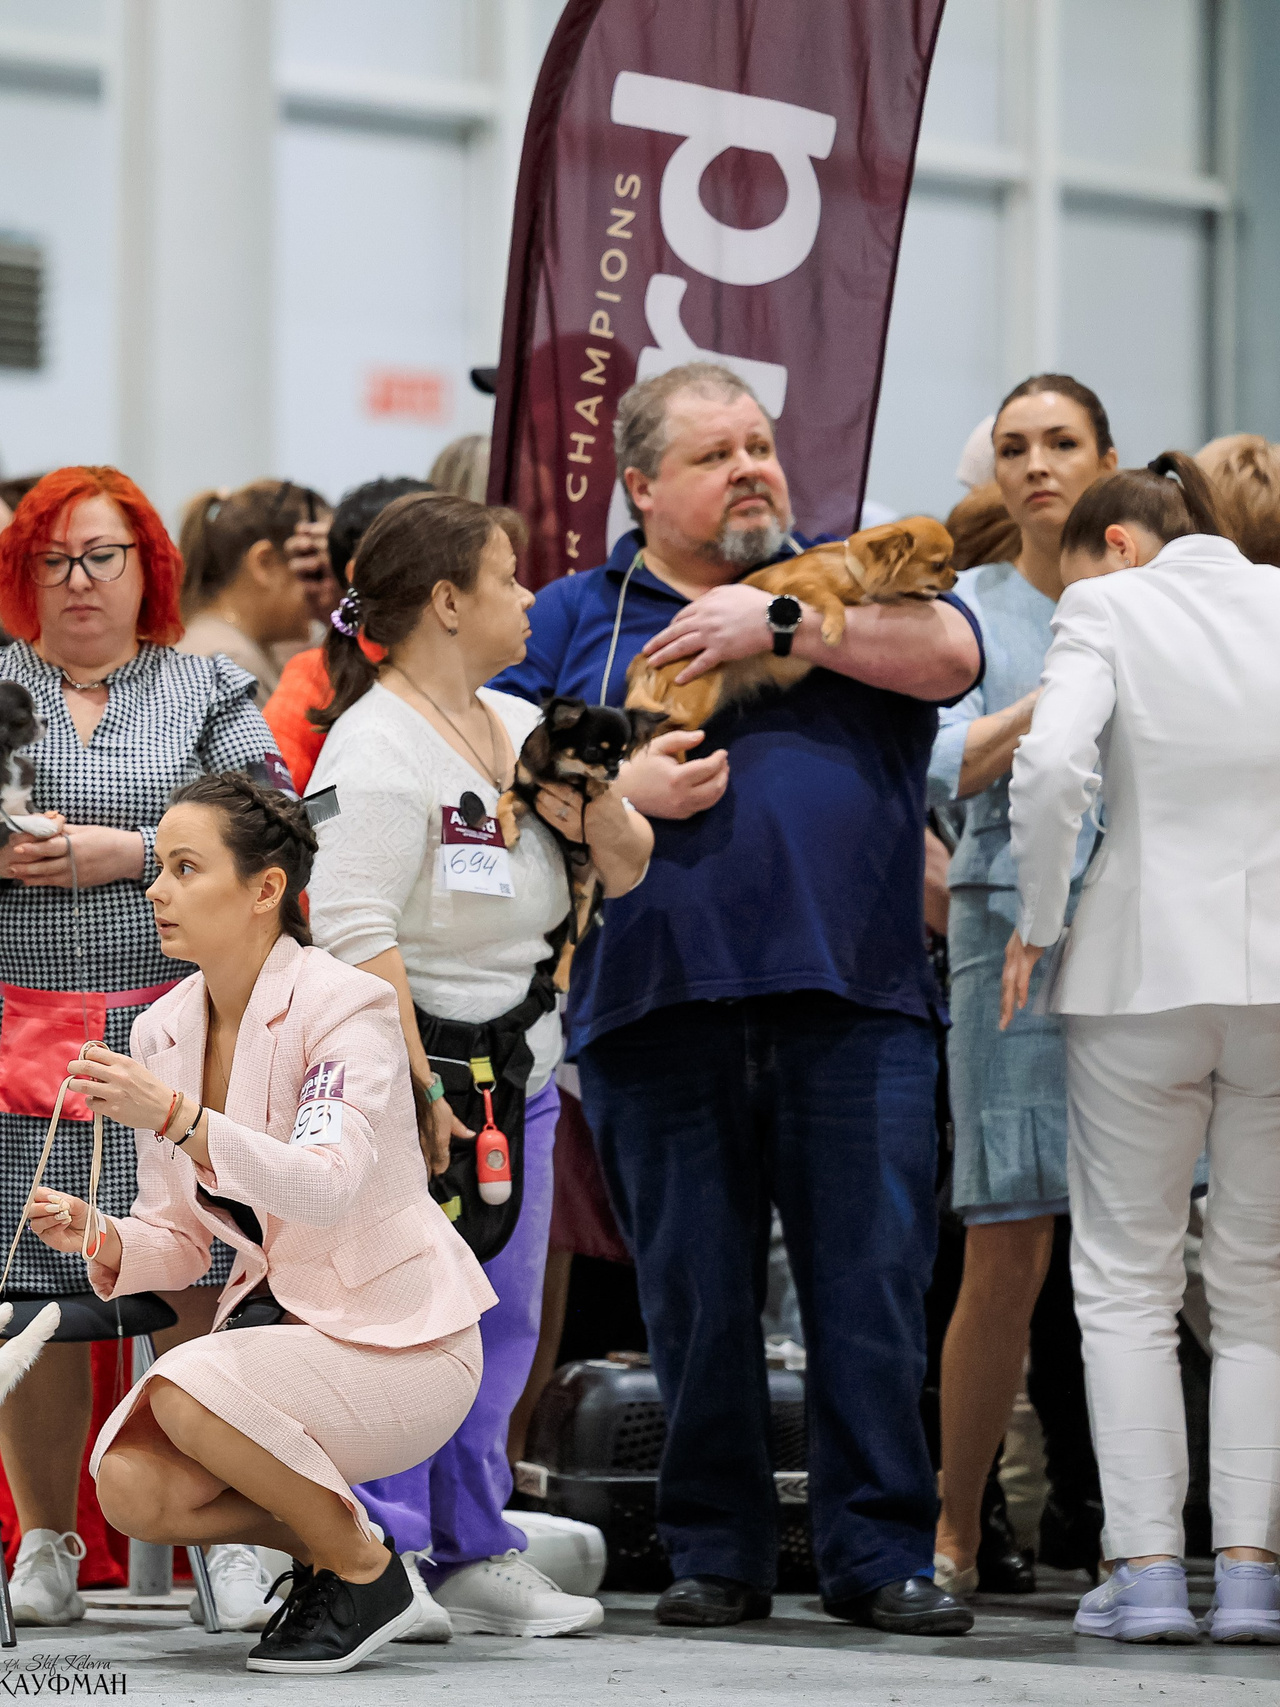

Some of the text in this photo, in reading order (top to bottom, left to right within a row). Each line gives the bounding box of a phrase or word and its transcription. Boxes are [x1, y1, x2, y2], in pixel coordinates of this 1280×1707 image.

[565, 173, 642, 502] CHAMPIONS
[450, 848, 500, 876] 694
[293, 1104, 332, 1140] 93
